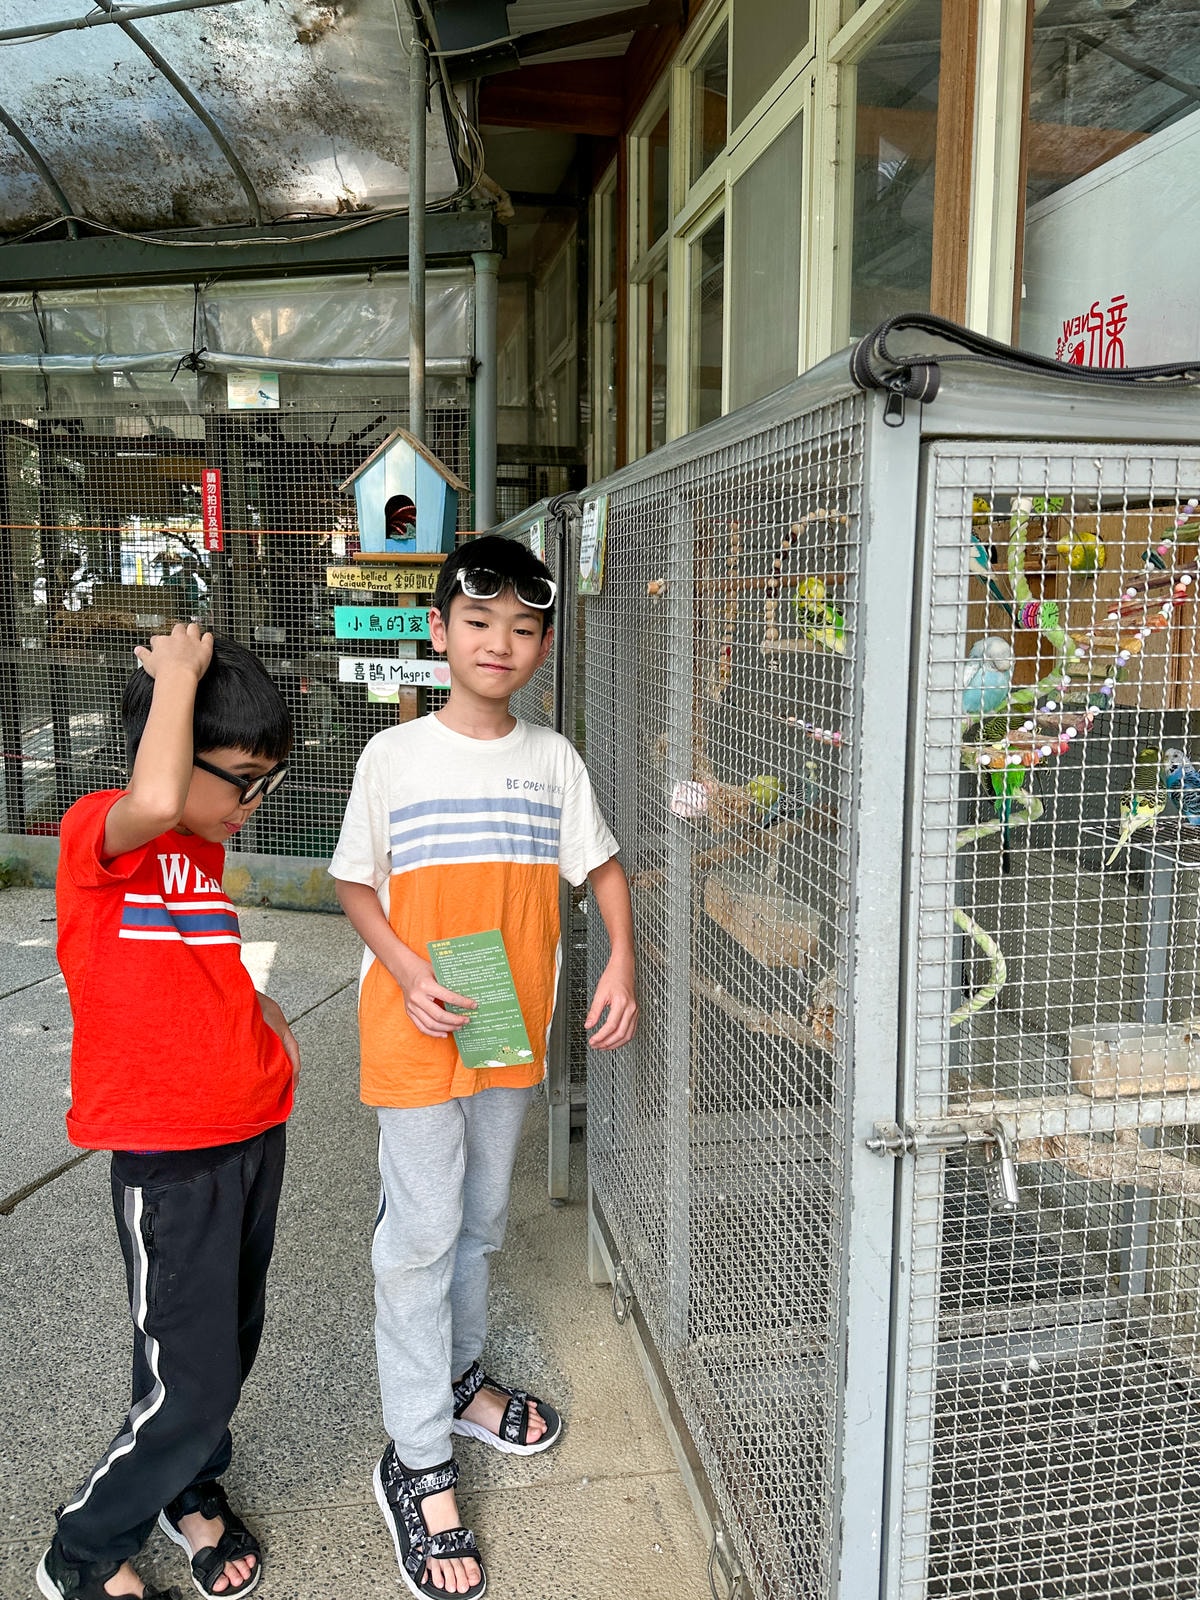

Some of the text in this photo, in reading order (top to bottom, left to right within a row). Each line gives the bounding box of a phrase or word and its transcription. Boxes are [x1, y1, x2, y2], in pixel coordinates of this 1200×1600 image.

[331, 571, 388, 581] White-bellied
[339, 579, 392, 591] Caique Parrot
[348, 612, 430, 633] 小鳥的家
[389, 665, 431, 682] Magpie
[506, 778, 520, 789] BE
[523, 780, 545, 792] OPEN
